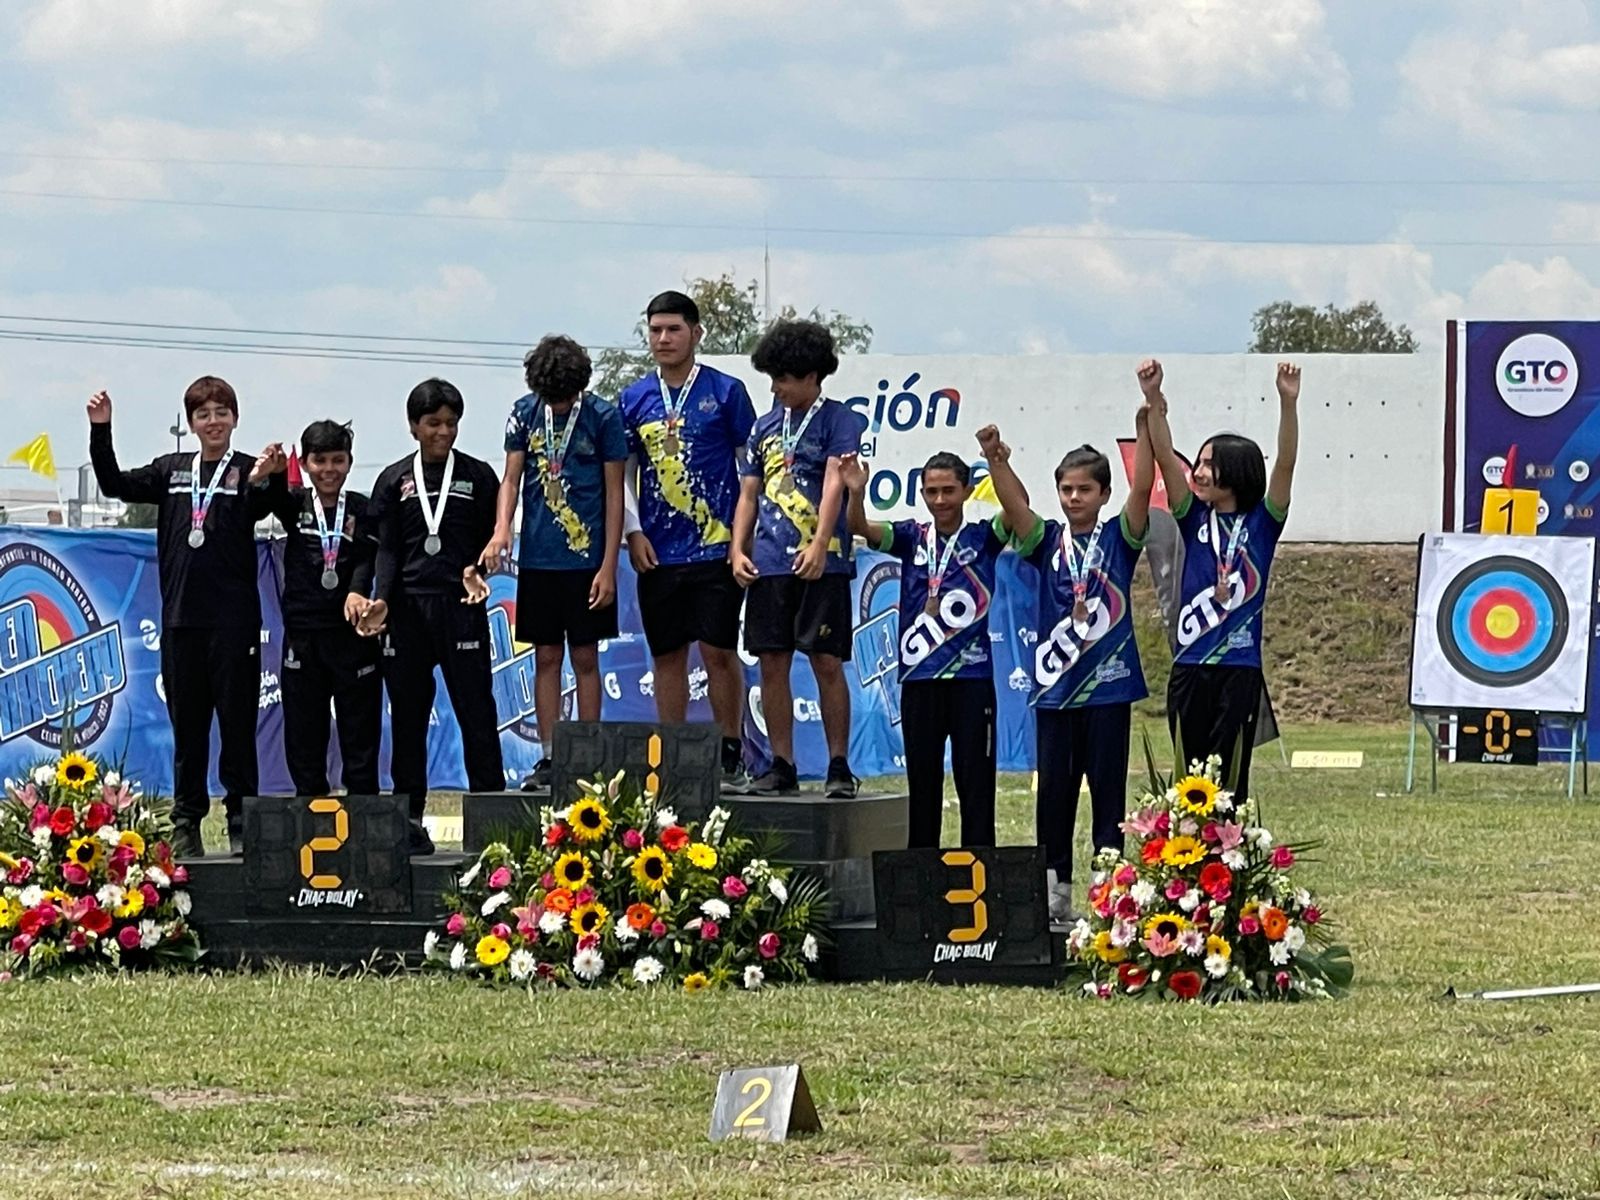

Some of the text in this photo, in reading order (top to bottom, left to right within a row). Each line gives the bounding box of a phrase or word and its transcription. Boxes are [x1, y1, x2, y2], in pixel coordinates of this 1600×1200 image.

[1505, 360, 1568, 385] GTO
[1499, 499, 1514, 535] 1
[900, 589, 976, 666] GTO
[300, 799, 349, 889] 2
[941, 851, 988, 942] 3
[733, 1077, 772, 1127] 2
